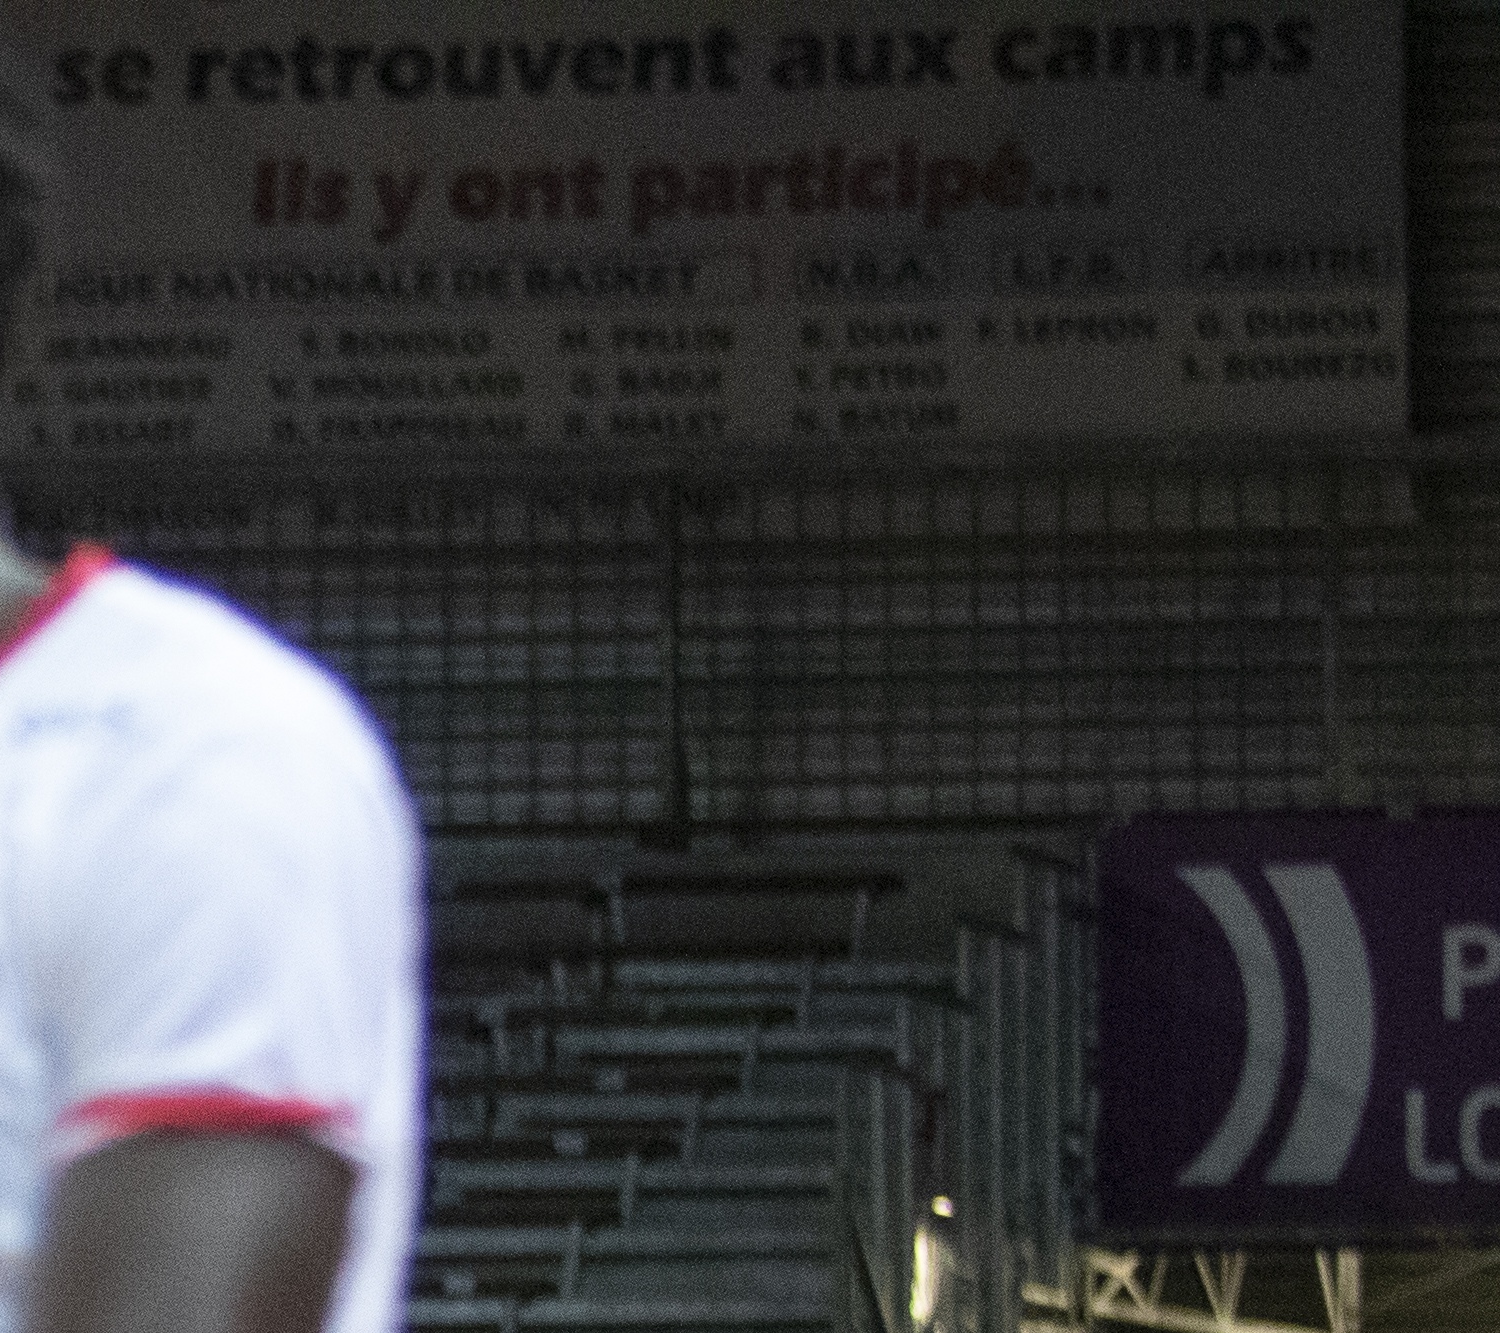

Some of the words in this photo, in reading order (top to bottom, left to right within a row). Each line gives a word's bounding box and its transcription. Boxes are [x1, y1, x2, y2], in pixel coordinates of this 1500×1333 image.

[50, 42, 152, 106] se
[184, 24, 742, 104] retrouvent
[768, 33, 960, 92] aux
[991, 16, 1316, 102] camps
[253, 157, 352, 226] Ils
[373, 166, 426, 243] y
[448, 158, 605, 225] ont
[172, 264, 439, 303] NATIONALE
[453, 265, 508, 298] DE
[524, 262, 700, 295] BASKET
